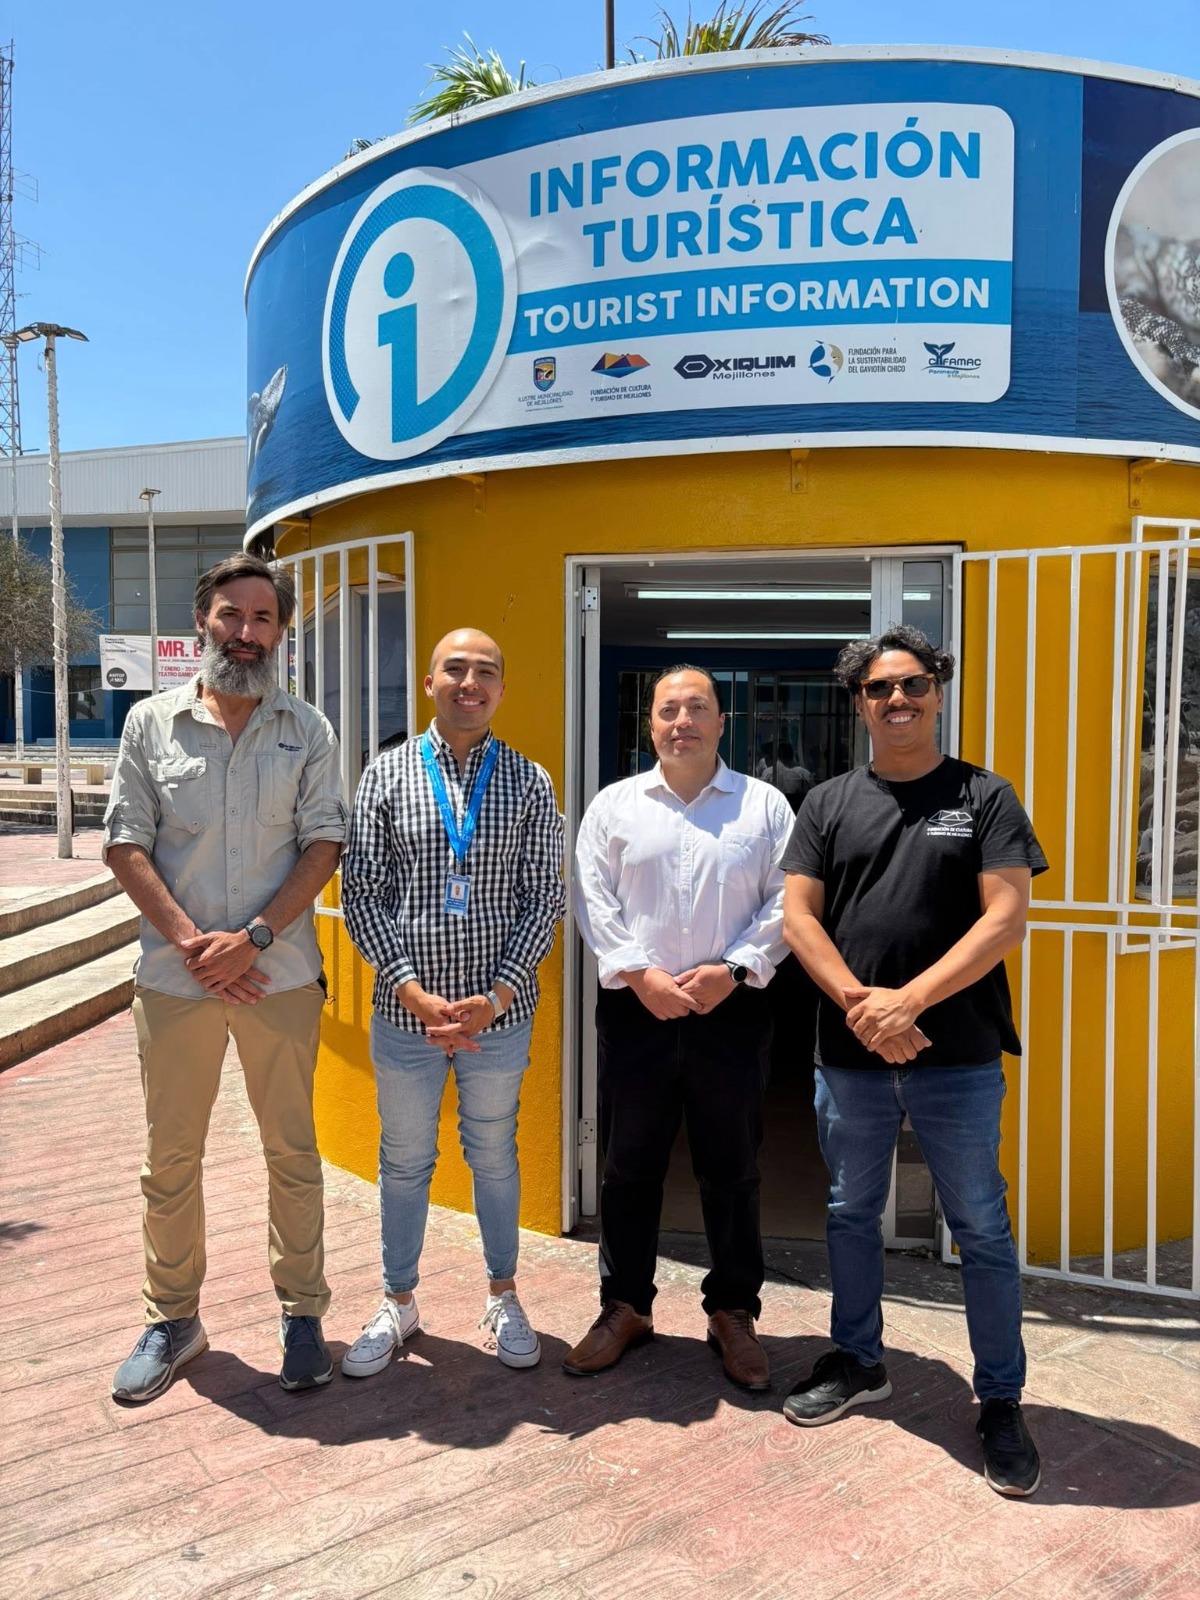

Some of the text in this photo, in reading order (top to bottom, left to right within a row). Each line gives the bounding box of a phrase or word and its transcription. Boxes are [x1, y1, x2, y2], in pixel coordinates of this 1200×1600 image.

[529, 116, 981, 218] INFORMACIÓN
[582, 193, 918, 268] TURÍSTICA
[523, 277, 990, 337] TOURIST INFORMATION
[848, 346, 898, 356] FUNDACIÓN PARA
[848, 356, 907, 365] LA SUSTENTABILIDAD
[848, 365, 859, 374] DEL
[887, 365, 906, 373] CHICO
[712, 371, 776, 381] Mejillones
[590, 386, 620, 396] FUNDACIÓN
[628, 384, 652, 392] CULTURA
[157, 640, 189, 658] MR.
